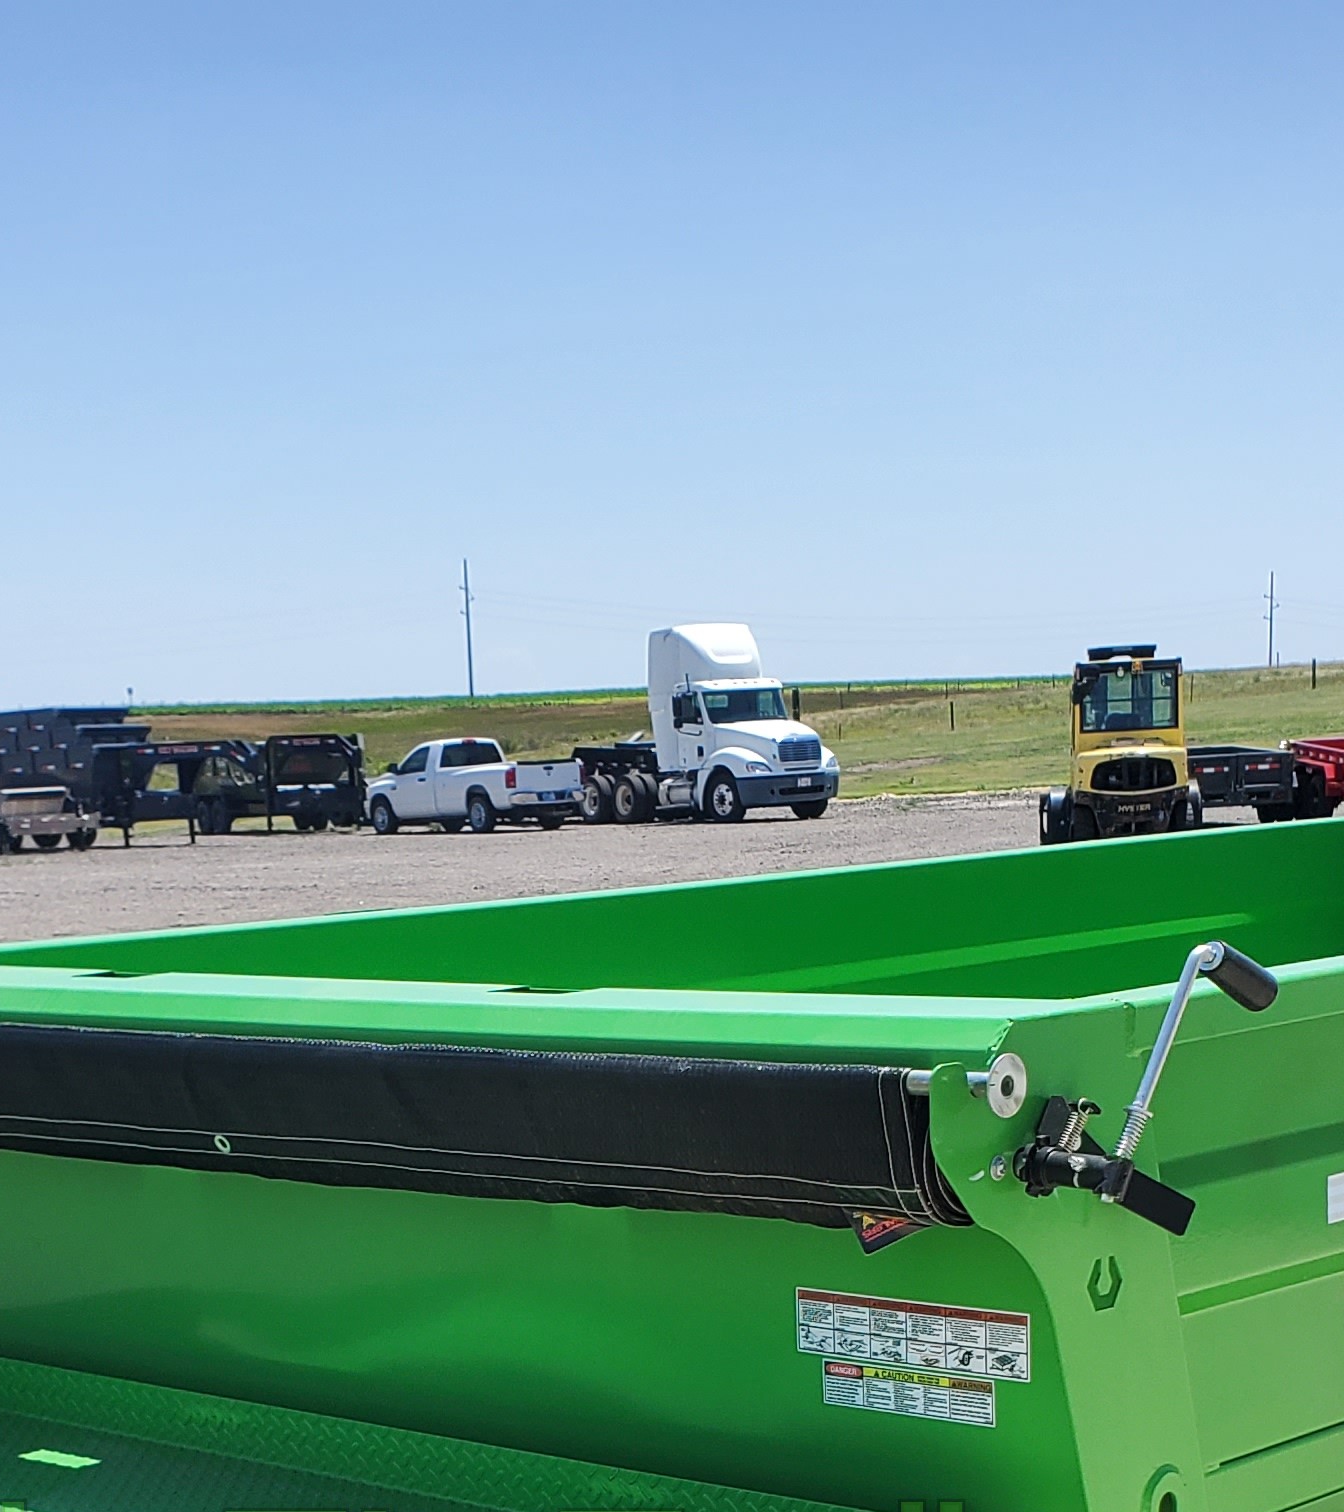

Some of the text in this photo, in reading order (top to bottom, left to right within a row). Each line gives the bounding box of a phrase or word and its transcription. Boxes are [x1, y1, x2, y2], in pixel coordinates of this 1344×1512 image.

[829, 1365, 857, 1376] DANGER
[881, 1370, 915, 1383] CAUTION
[955, 1380, 991, 1392] WARNING
